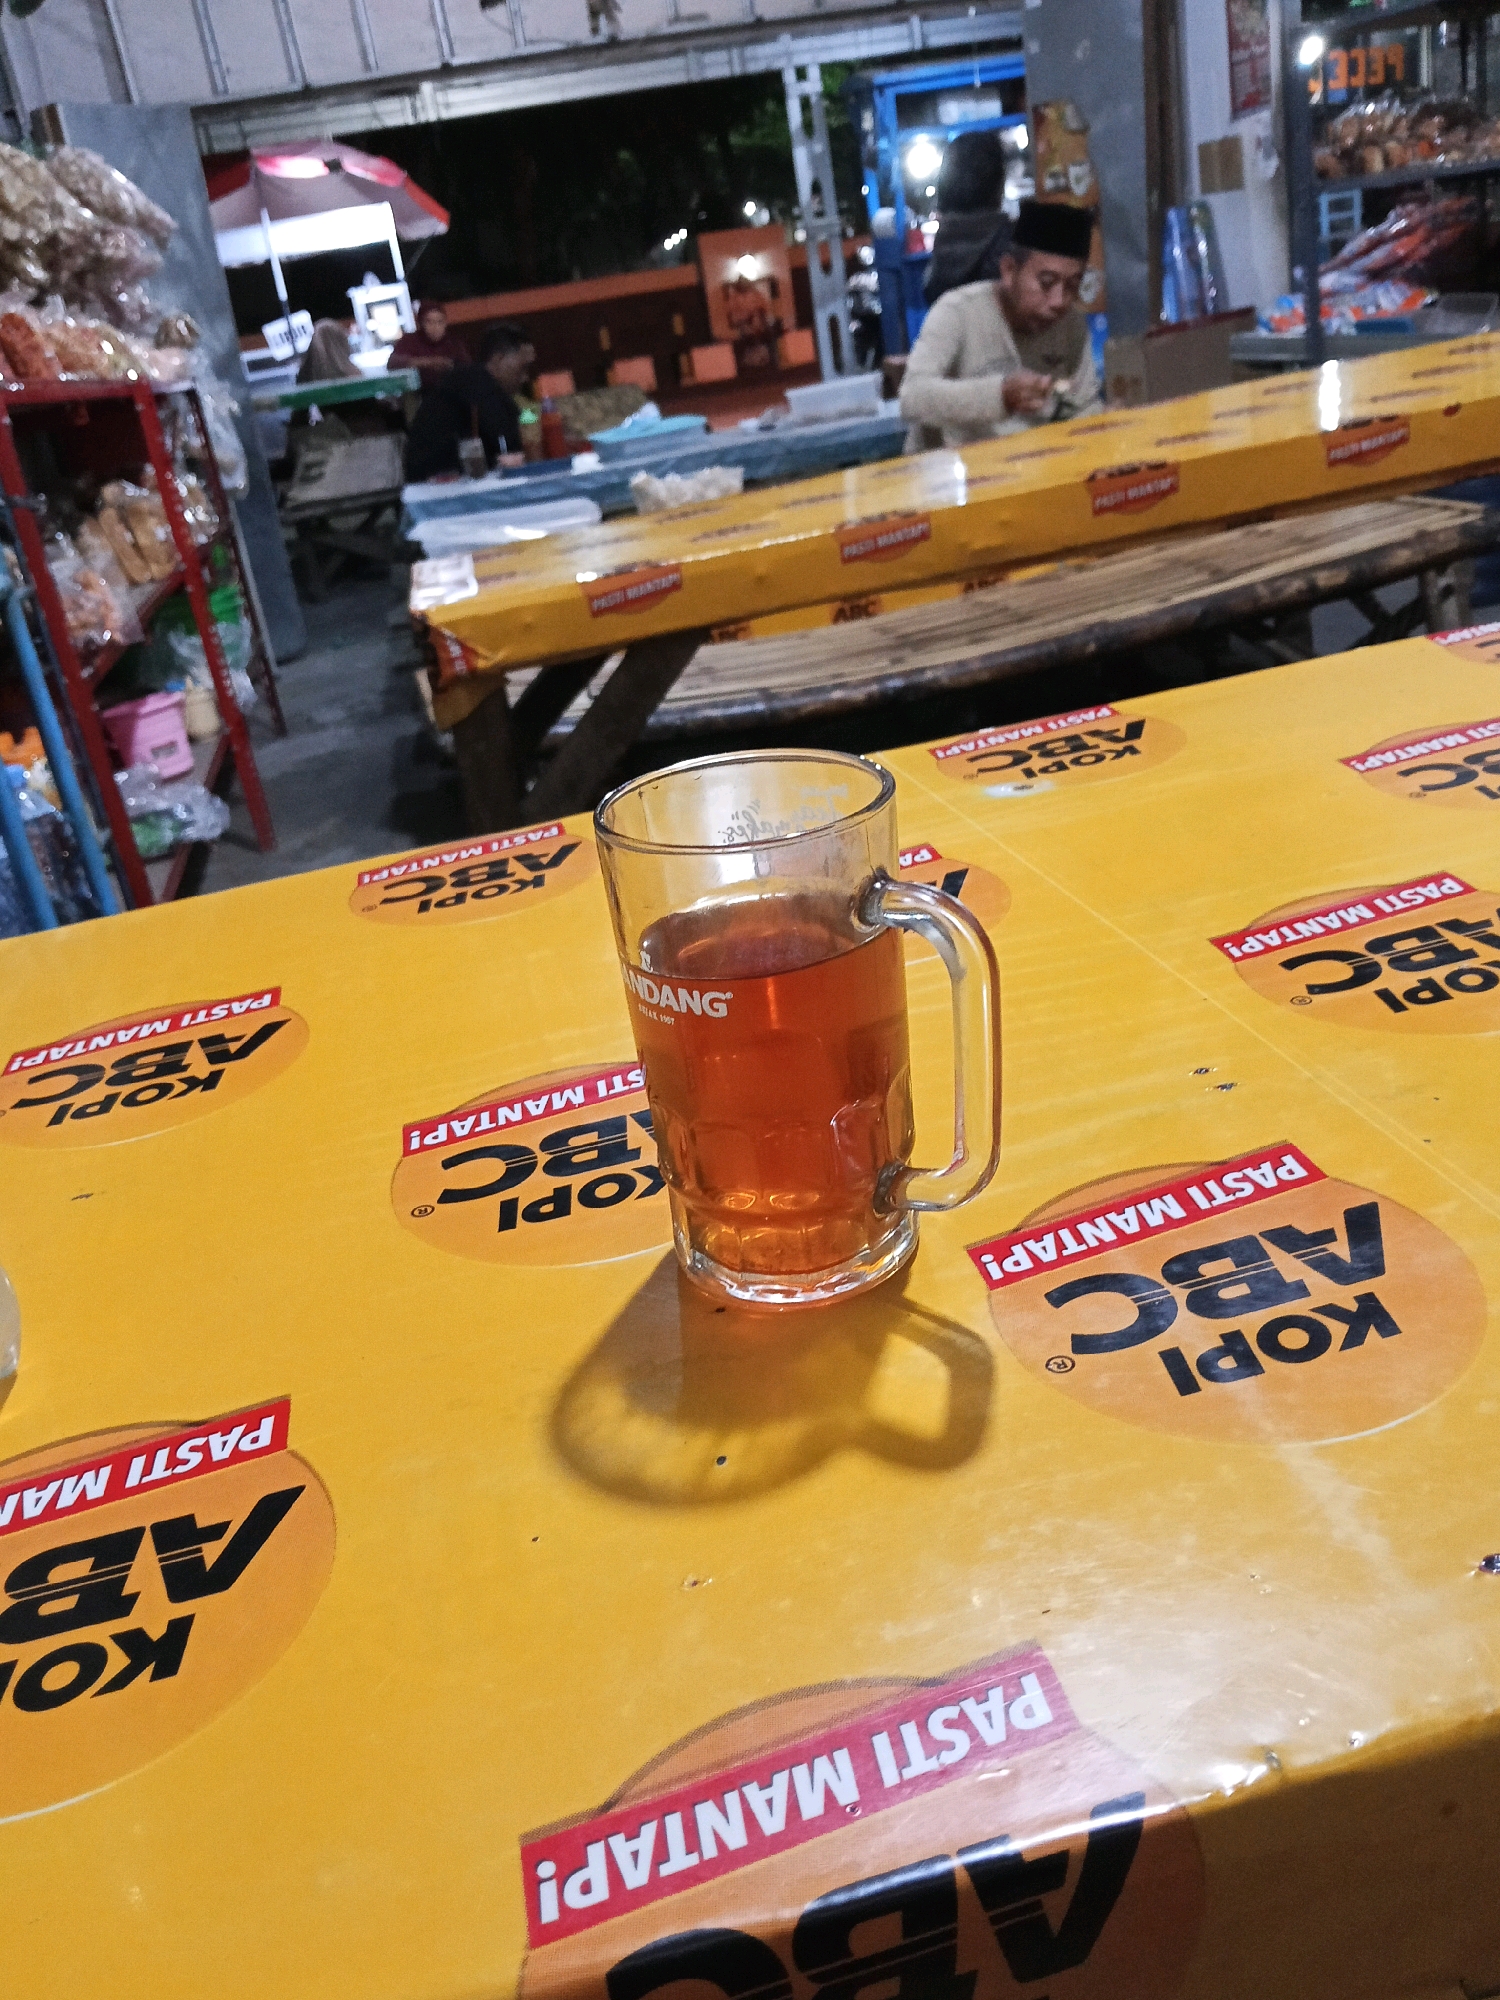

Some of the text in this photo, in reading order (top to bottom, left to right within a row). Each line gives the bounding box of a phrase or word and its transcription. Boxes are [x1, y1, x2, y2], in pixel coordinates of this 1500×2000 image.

[966, 719, 1146, 774] ABC
[1048, 707, 1112, 730] PASTI
[1020, 744, 1141, 779] KOPI
[1350, 733, 1469, 772] MANTAP!
[362, 825, 559, 885] PASTI MANTAP!
[379, 841, 582, 905] ABC
[417, 874, 545, 914] KOPI
[1223, 877, 1465, 958] PASTI MANTAP!
[1374, 960, 1500, 1013] OPI
[9, 1018, 292, 1110] ABC
[10, 993, 272, 1072] PASTI MANTAP!
[45, 1068, 226, 1128] KOPI
[409, 1085, 586, 1150] MANTAP!
[979, 1154, 1309, 1281] PASTI MANTAP!
[1044, 1201, 1386, 1355] ABC
[1158, 1292, 1403, 1397] KOPI
[124, 1415, 275, 1488] PASTI
[535, 1672, 1055, 1925] PASTI MANTAP!
